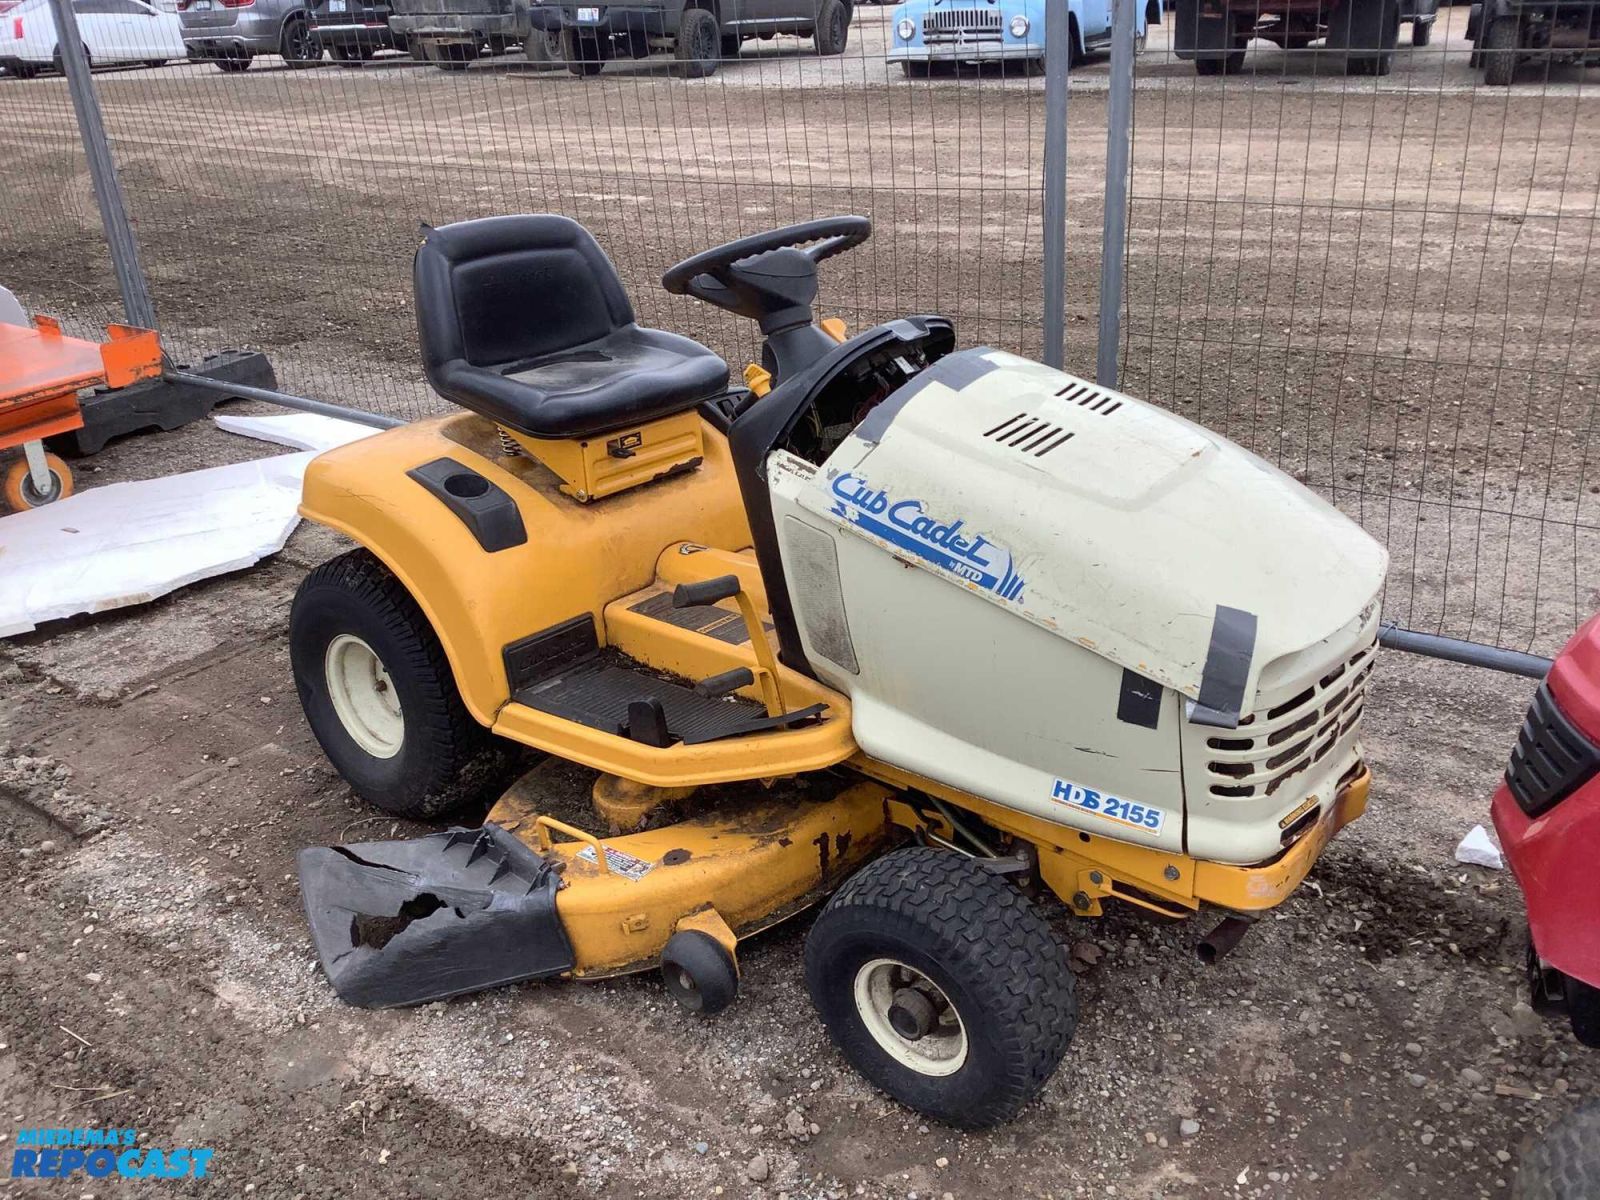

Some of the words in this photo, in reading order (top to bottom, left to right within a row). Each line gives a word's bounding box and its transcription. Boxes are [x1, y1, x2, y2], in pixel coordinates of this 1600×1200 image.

[832, 473, 888, 514] Cub
[888, 501, 990, 567] Cadet
[954, 562, 983, 582] MTD
[1053, 780, 1100, 809] HDS
[1103, 798, 1160, 828] 2155
